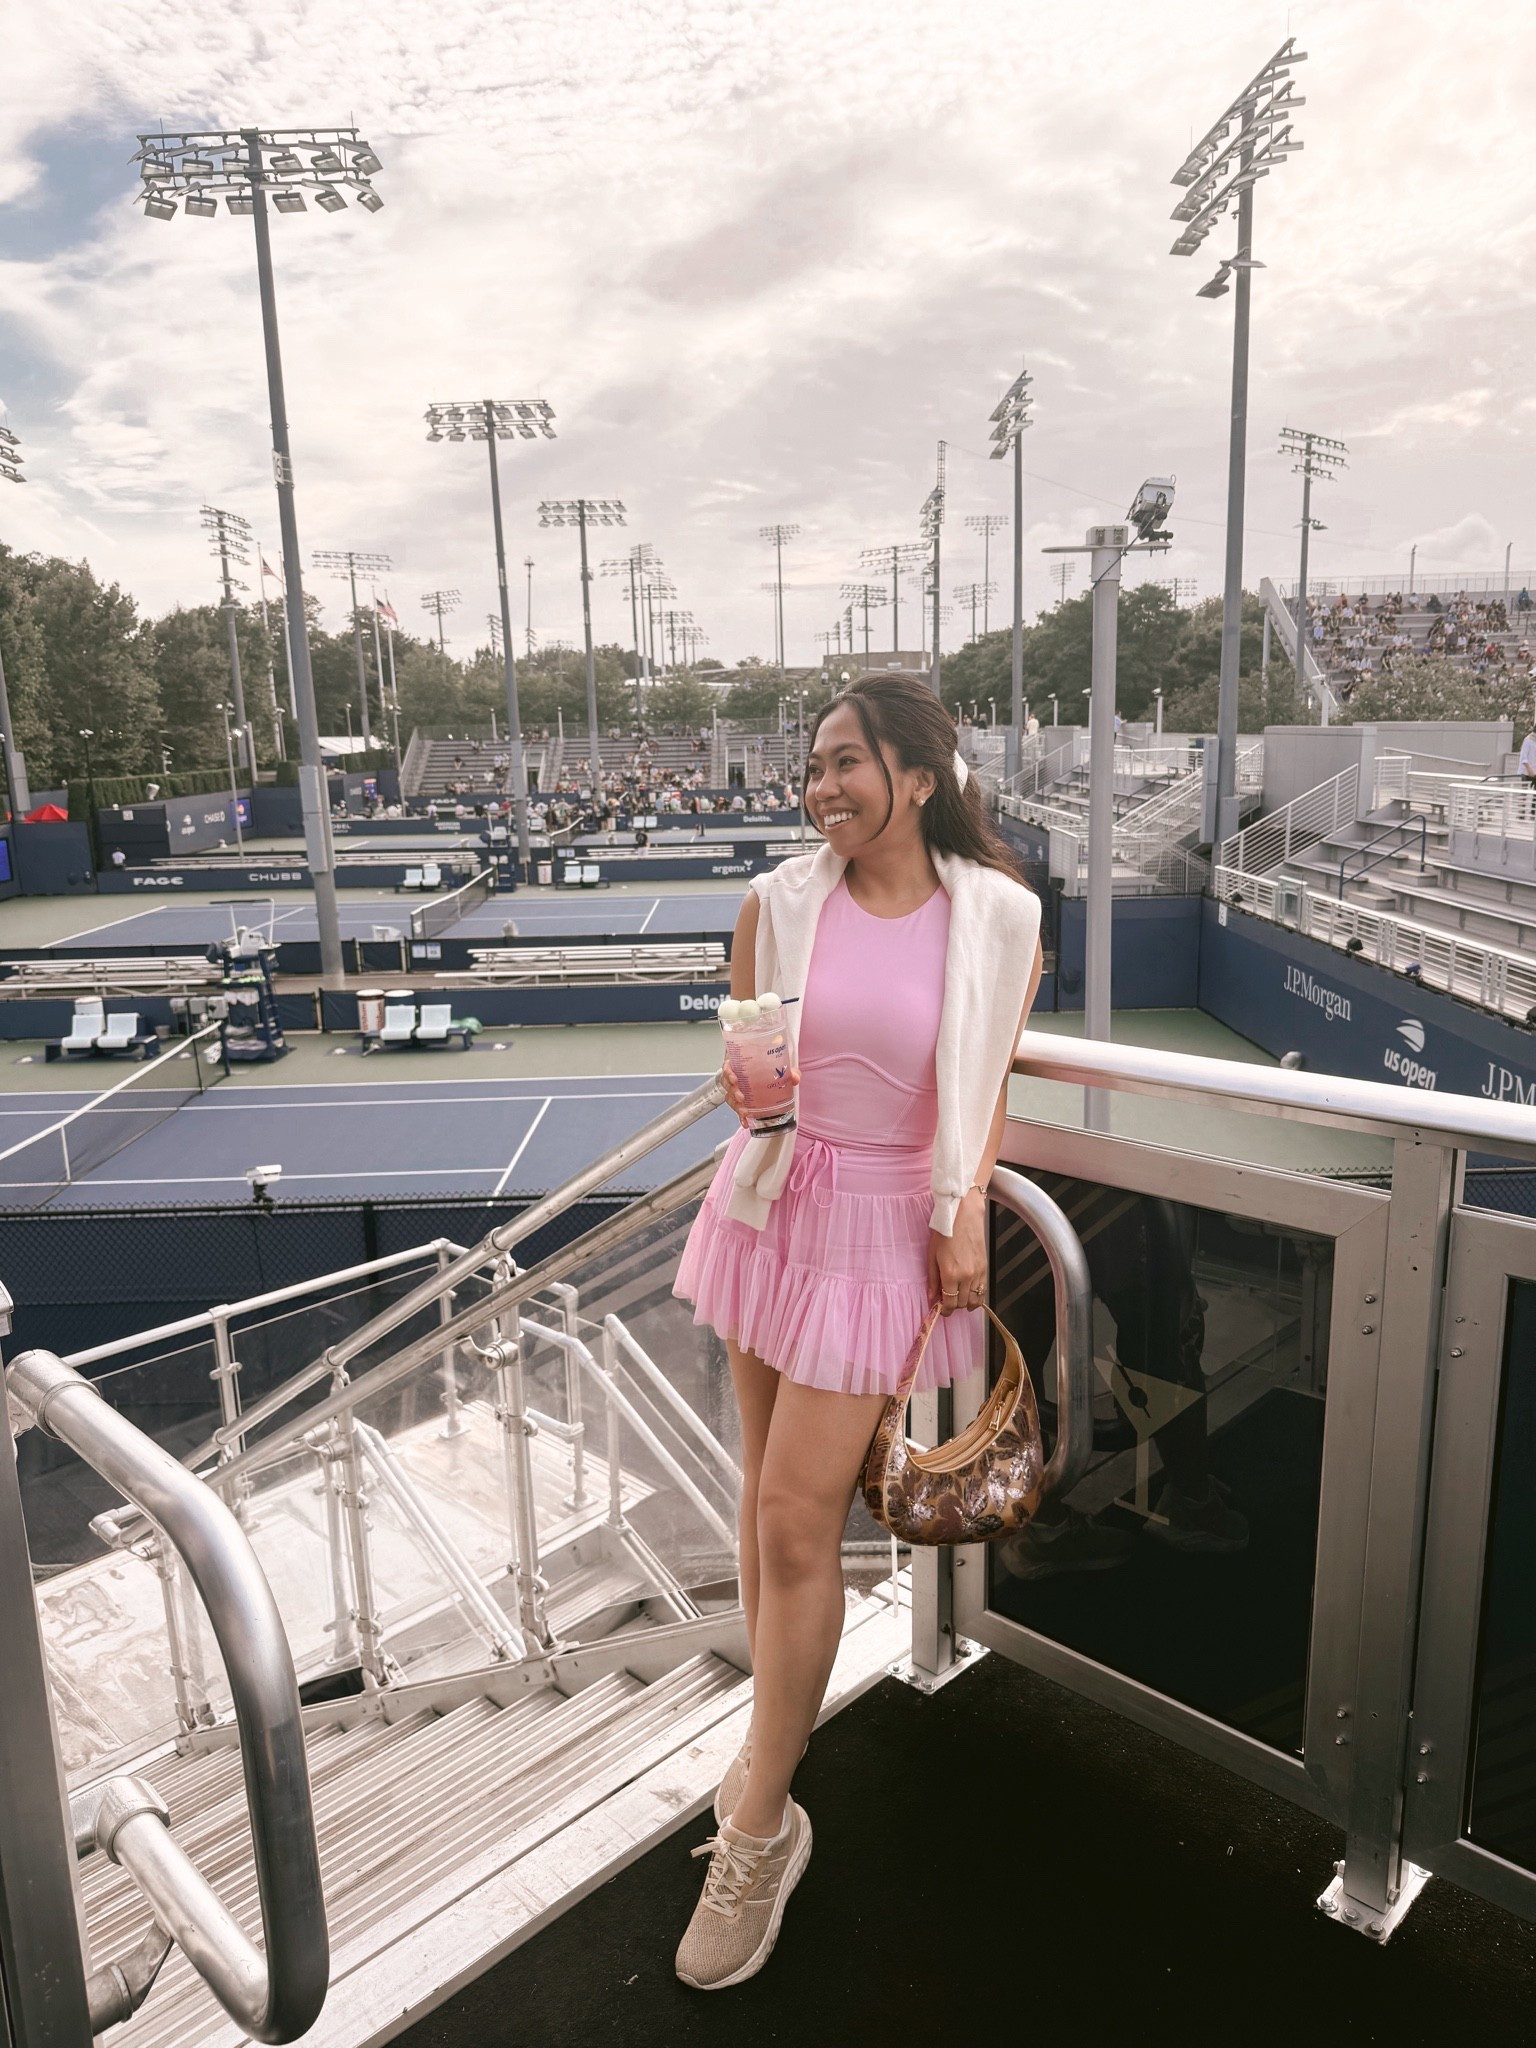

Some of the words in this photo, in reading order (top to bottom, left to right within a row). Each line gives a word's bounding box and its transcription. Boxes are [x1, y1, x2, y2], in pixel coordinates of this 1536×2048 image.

[248, 872, 302, 882] CHUBB
[712, 865, 746, 875] argenx
[1283, 965, 1351, 1022] J.P.Morgan
[1384, 1048, 1400, 1072] us
[1400, 1057, 1436, 1091] open
